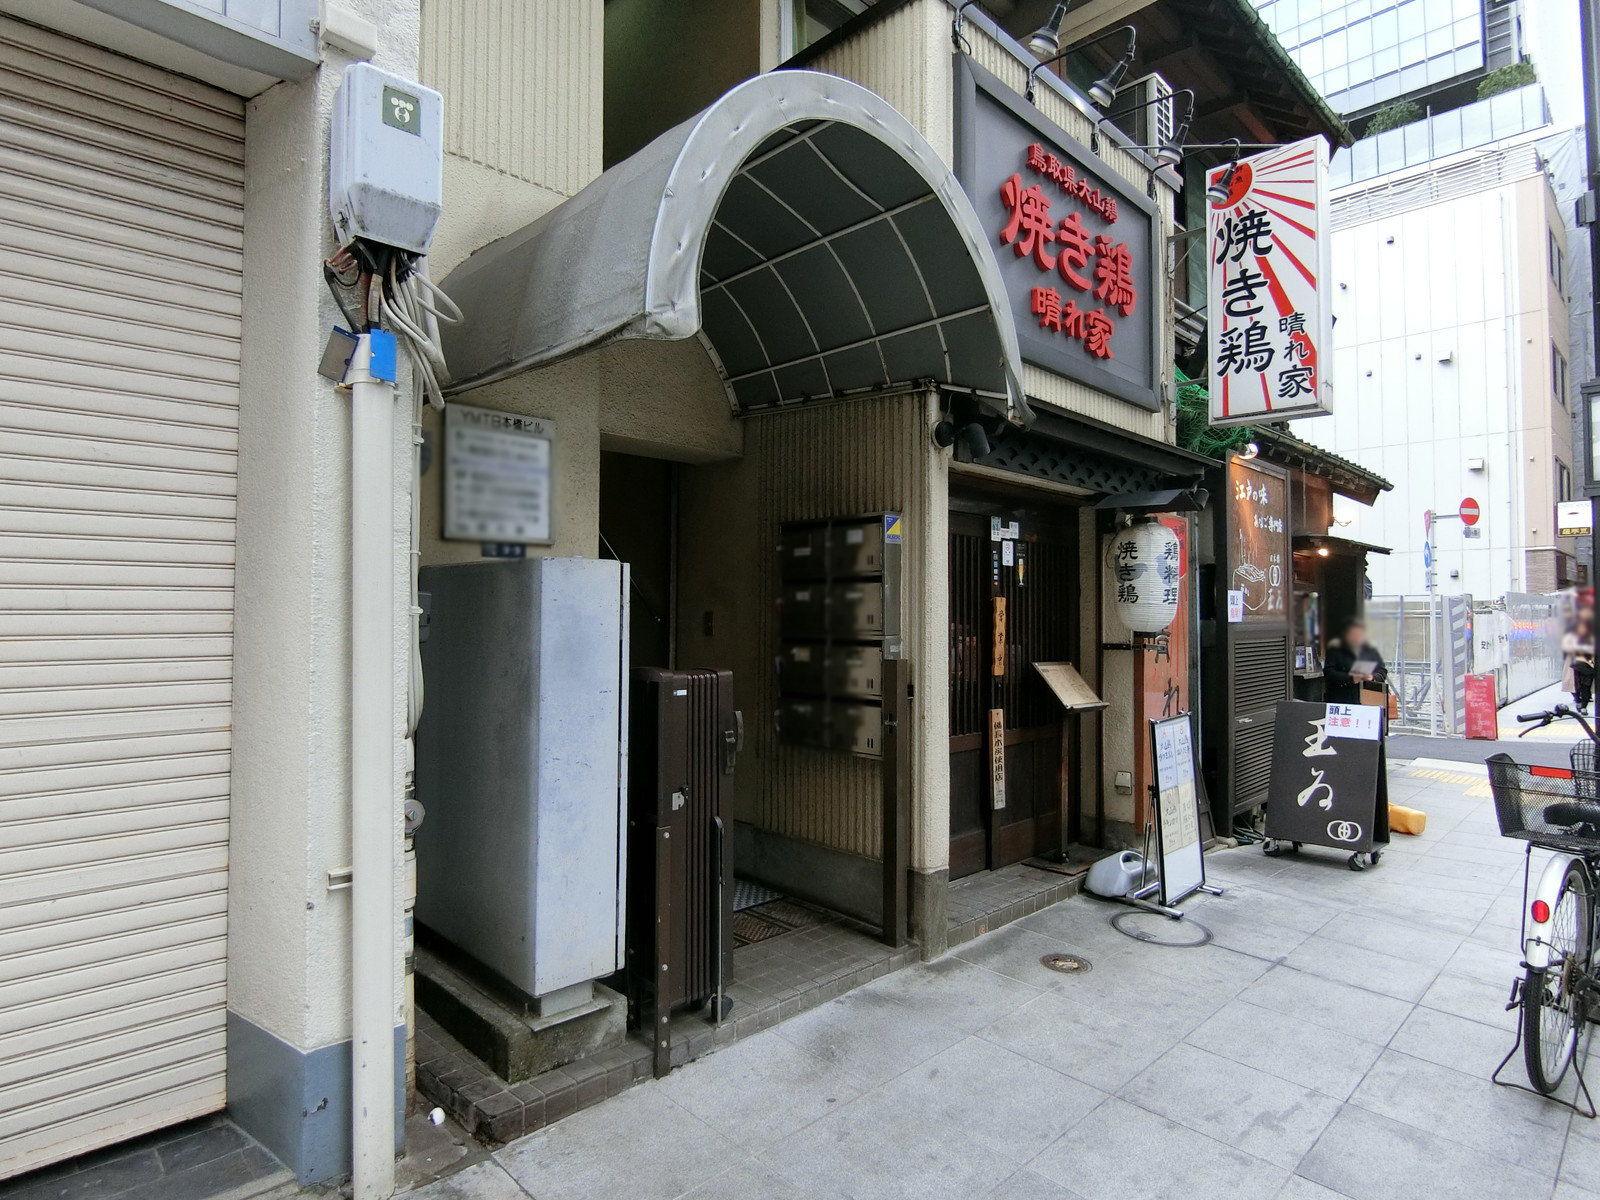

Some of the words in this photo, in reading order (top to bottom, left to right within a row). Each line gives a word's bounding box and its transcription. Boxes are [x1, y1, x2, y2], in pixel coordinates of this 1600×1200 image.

[1026, 142, 1118, 224] 鳥取県大山鶏
[999, 173, 1137, 317] 焼き鶏
[1031, 286, 1115, 359] 晴れ家
[1216, 208, 1275, 378] 焼き鶏
[1277, 311, 1314, 399] 晴れ家
[1235, 480, 1269, 506] 江戸の味
[1117, 541, 1140, 604] 焼き鶏
[1162, 541, 1179, 605] 鶏料理
[1329, 704, 1352, 716] 頭上
